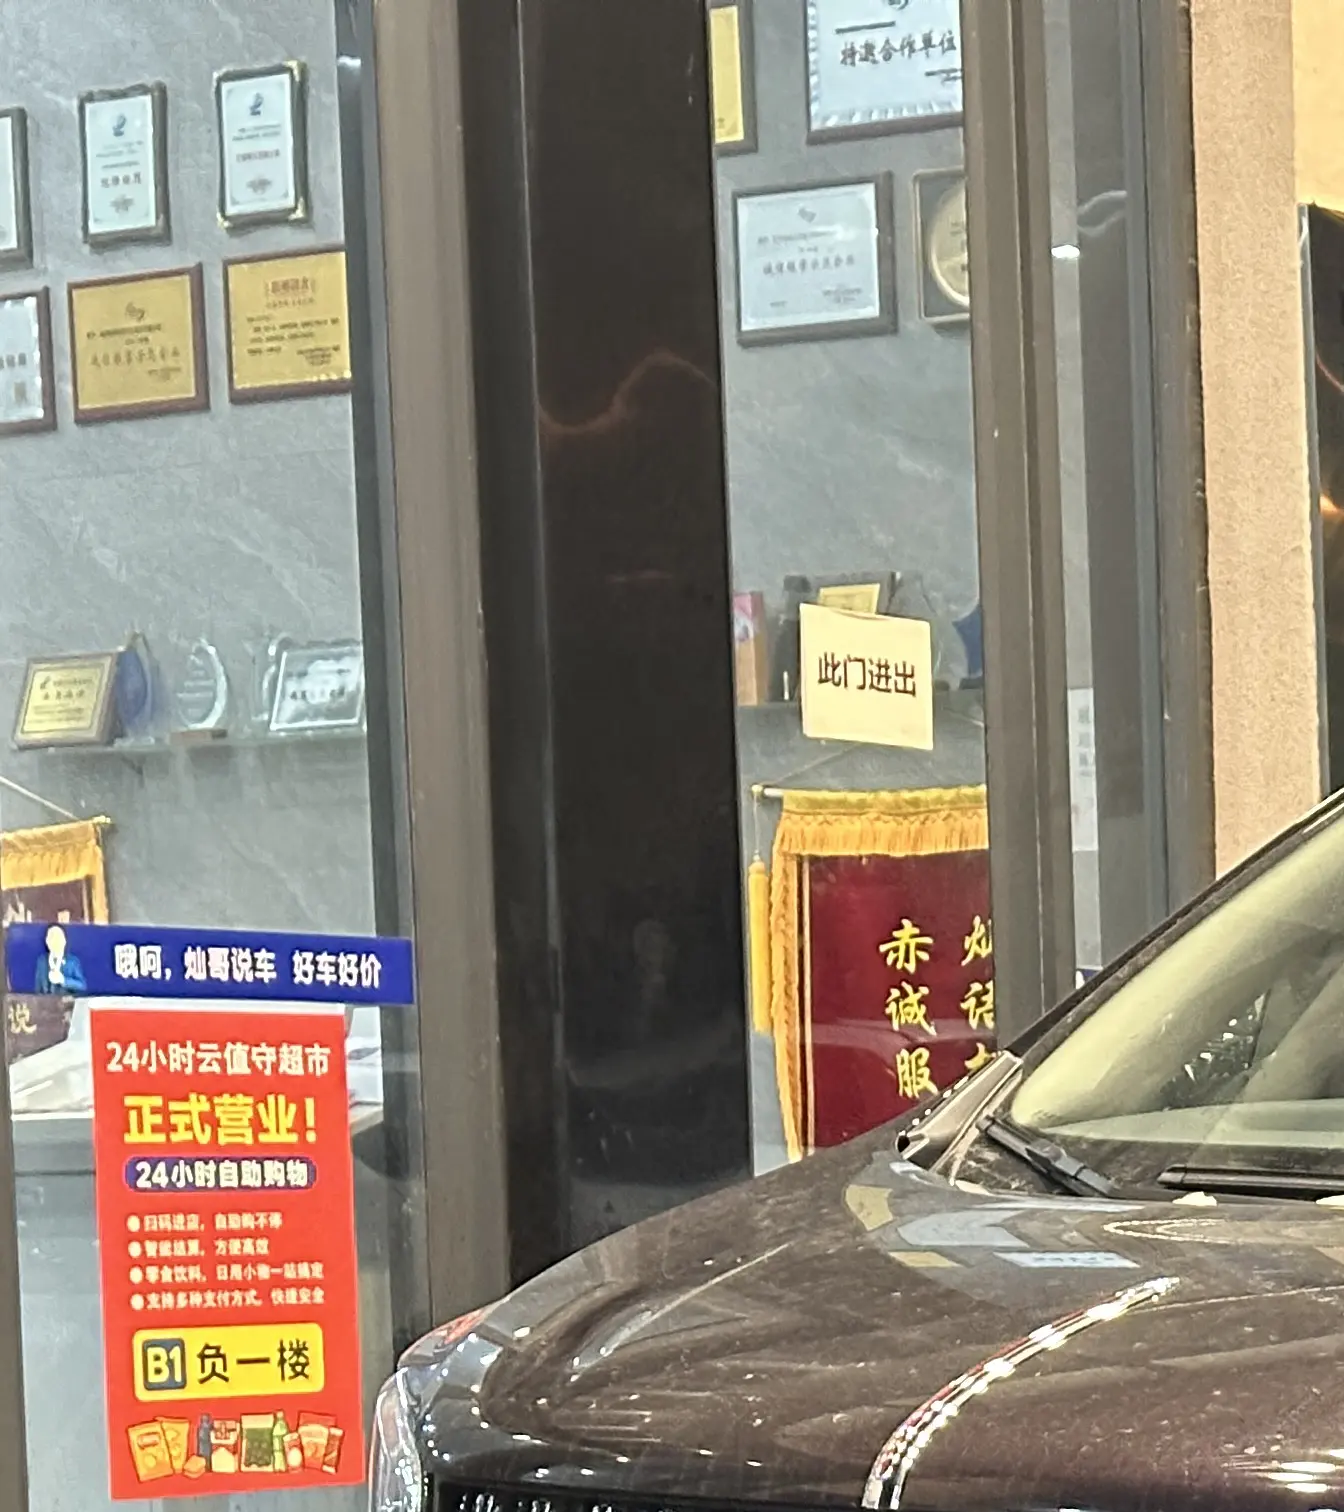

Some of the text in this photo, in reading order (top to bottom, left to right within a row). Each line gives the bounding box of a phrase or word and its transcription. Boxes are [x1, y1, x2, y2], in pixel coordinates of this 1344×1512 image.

[816, 650, 917, 697] 此门进出
[291, 949, 382, 989] 好车好价
[105, 1039, 331, 1078] 24小时云值守超市
[135, 1159, 308, 1189] 24小时自助购物
[146, 1338, 311, 1384] B1 负一楼
